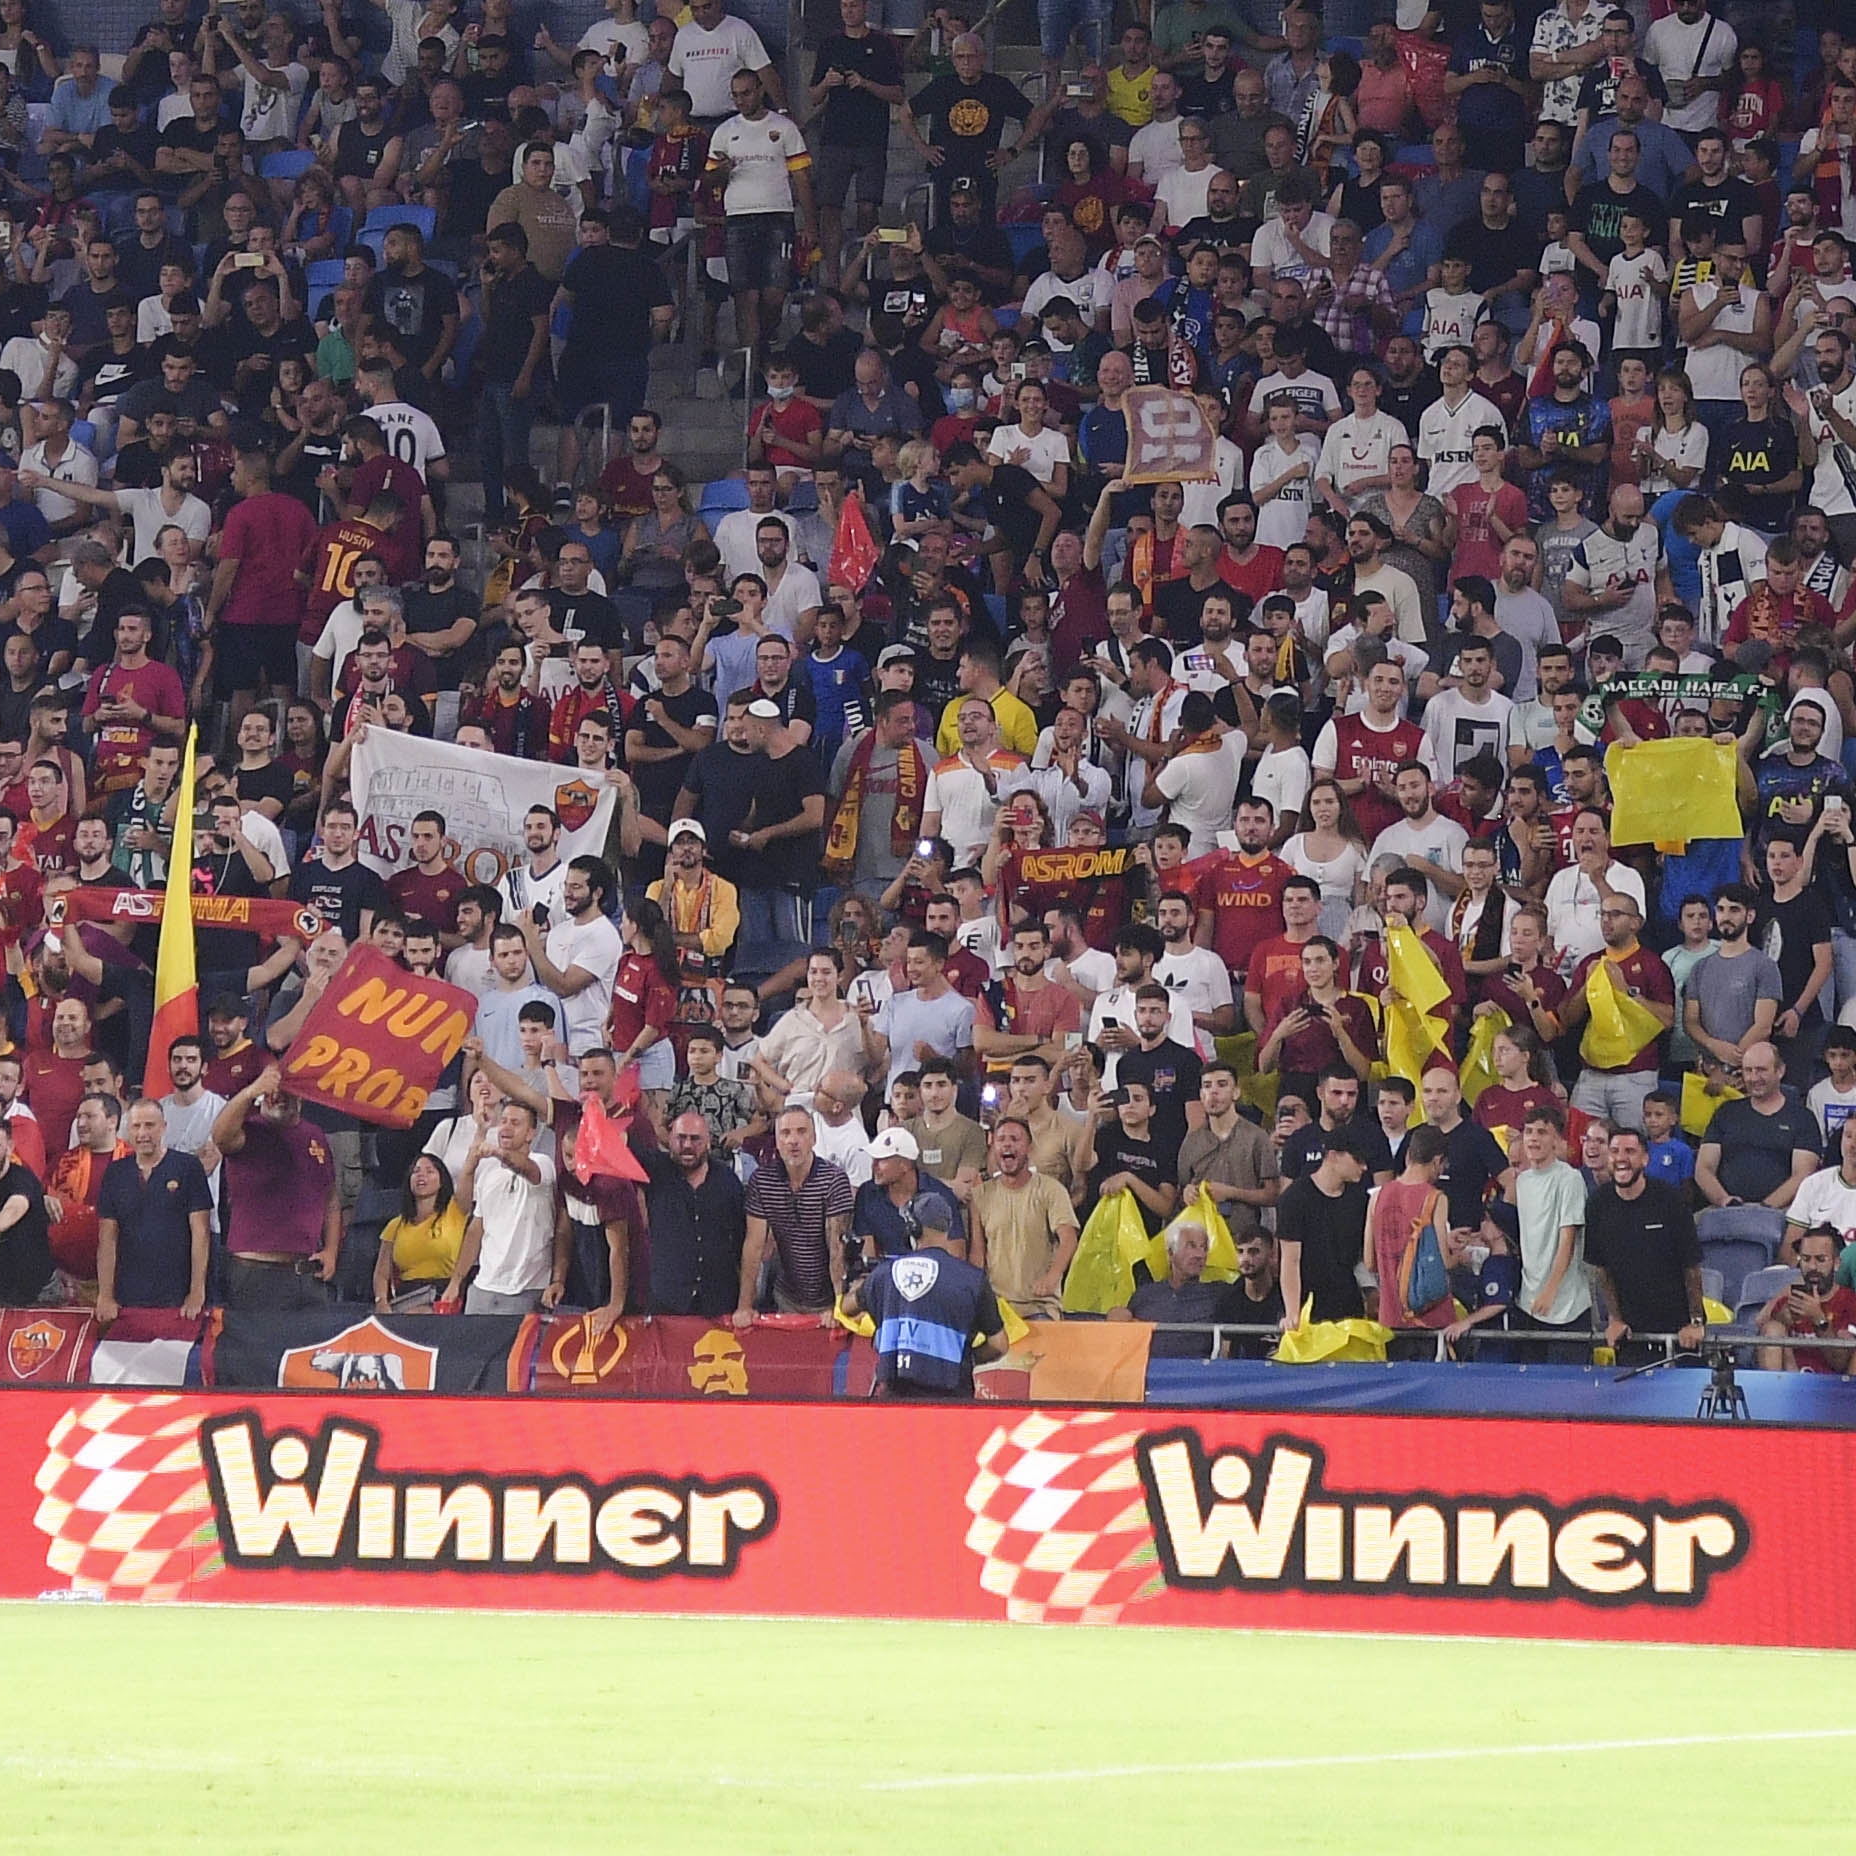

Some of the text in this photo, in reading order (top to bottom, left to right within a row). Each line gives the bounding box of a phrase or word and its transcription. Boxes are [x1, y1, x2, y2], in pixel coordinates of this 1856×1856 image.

[1431, 322, 1462, 339] AIA
[1728, 452, 1771, 474] AIA
[1601, 679, 1682, 697] MACCABI
[1685, 681, 1740, 695] HAIFA
[111, 892, 155, 918] AS
[1217, 892, 1273, 908] WIND
[896, 1320, 921, 1340] TV
[210, 1422, 765, 1567] Winner
[1148, 1438, 1736, 1594] Winner
